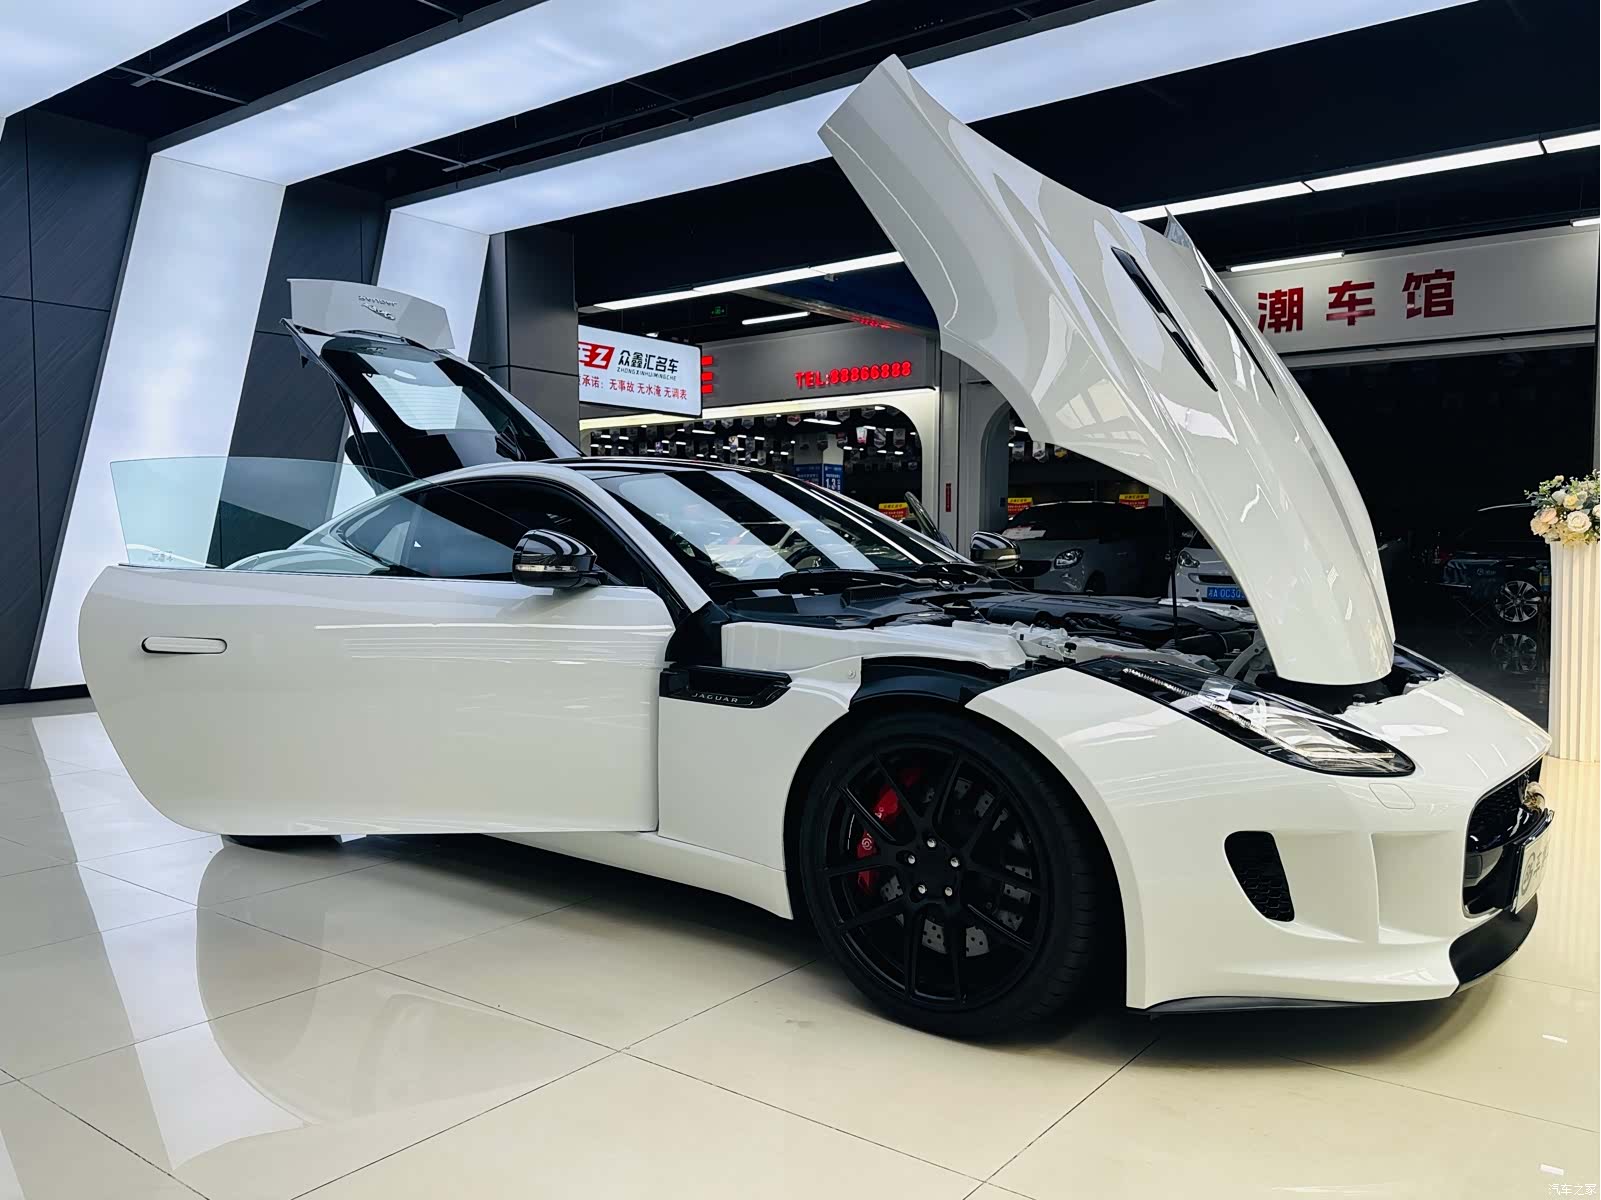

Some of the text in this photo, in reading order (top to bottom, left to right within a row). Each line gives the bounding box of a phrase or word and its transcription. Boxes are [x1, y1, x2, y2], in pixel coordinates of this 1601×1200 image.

[1257, 268, 1456, 334] 潮车馆
[618, 350, 679, 374] 众鑫汇名车
[609, 379, 635, 393] 无事故
[692, 693, 739, 702] JAGUAR
